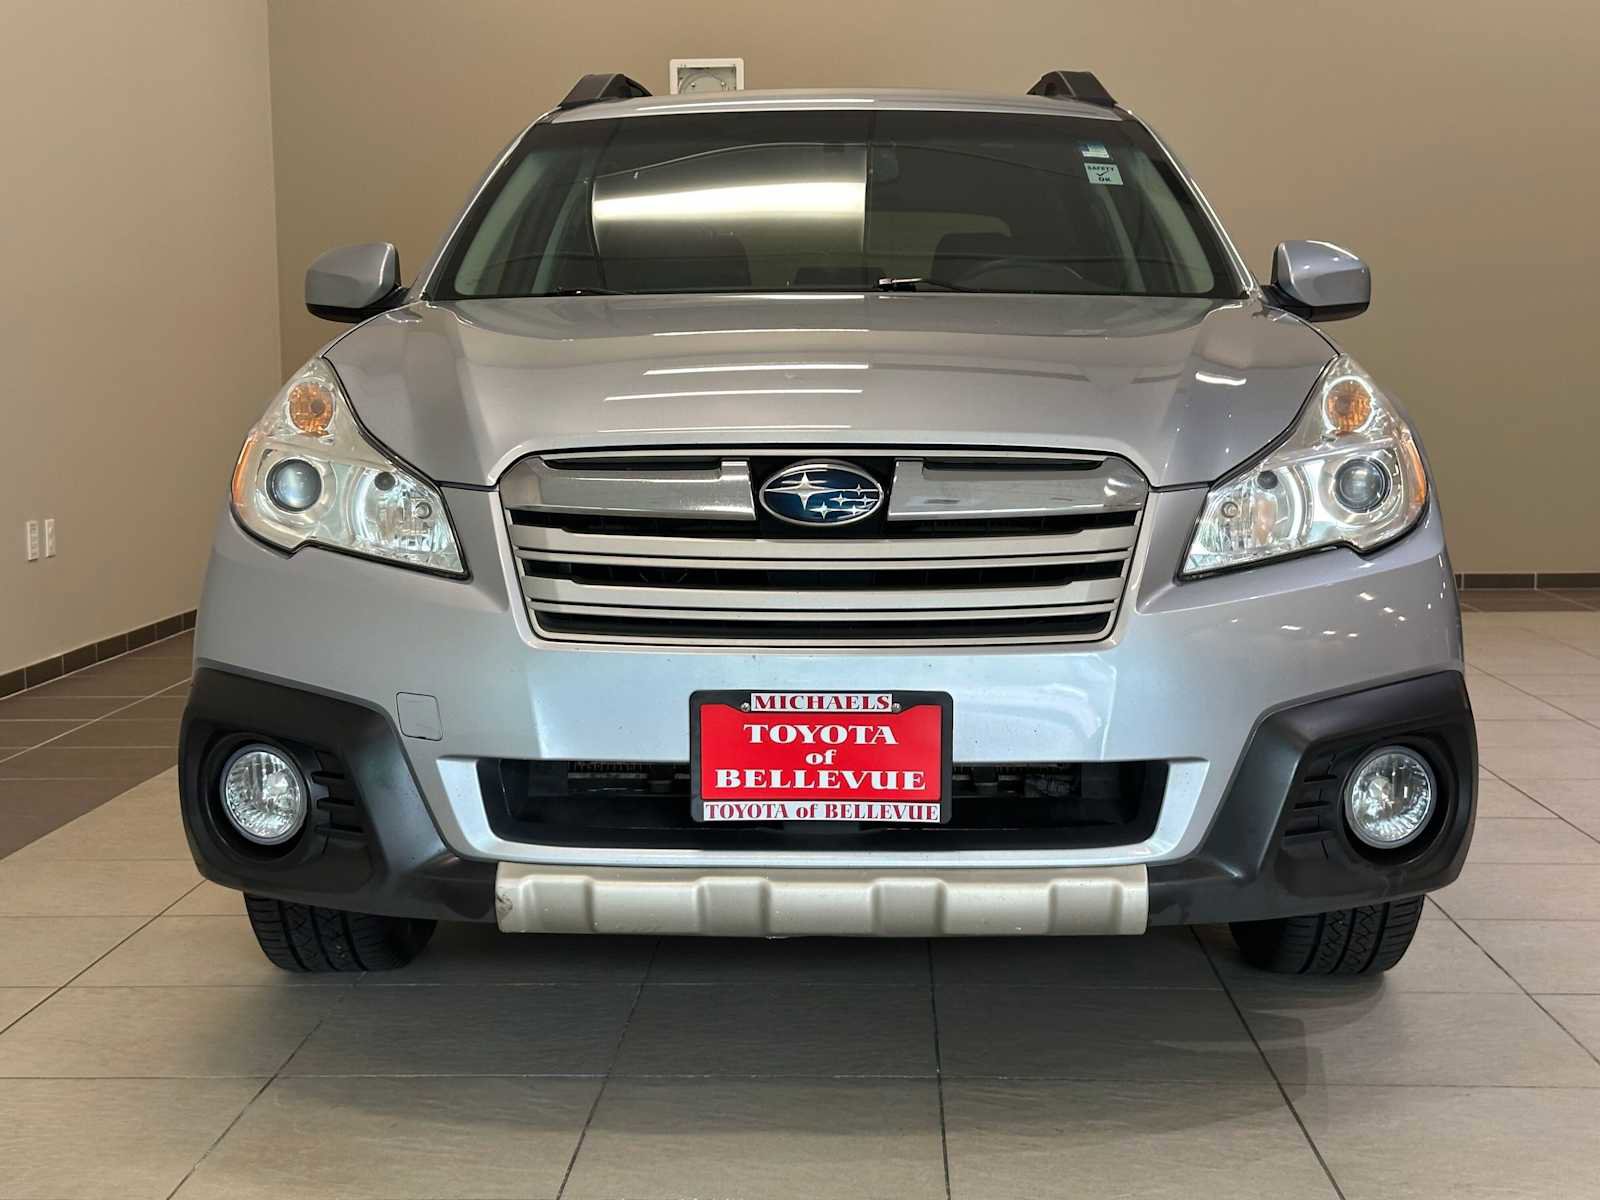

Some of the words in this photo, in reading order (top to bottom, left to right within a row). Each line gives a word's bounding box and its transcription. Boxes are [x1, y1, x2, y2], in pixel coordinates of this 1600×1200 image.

[754, 695, 891, 710] MICHAELS
[743, 724, 899, 745] TOYOTA
[805, 749, 837, 765] of
[715, 769, 926, 790] BELLEVUE
[705, 803, 789, 819] TOYOTA
[796, 803, 818, 819] of
[825, 804, 939, 821] BELLEVUE
